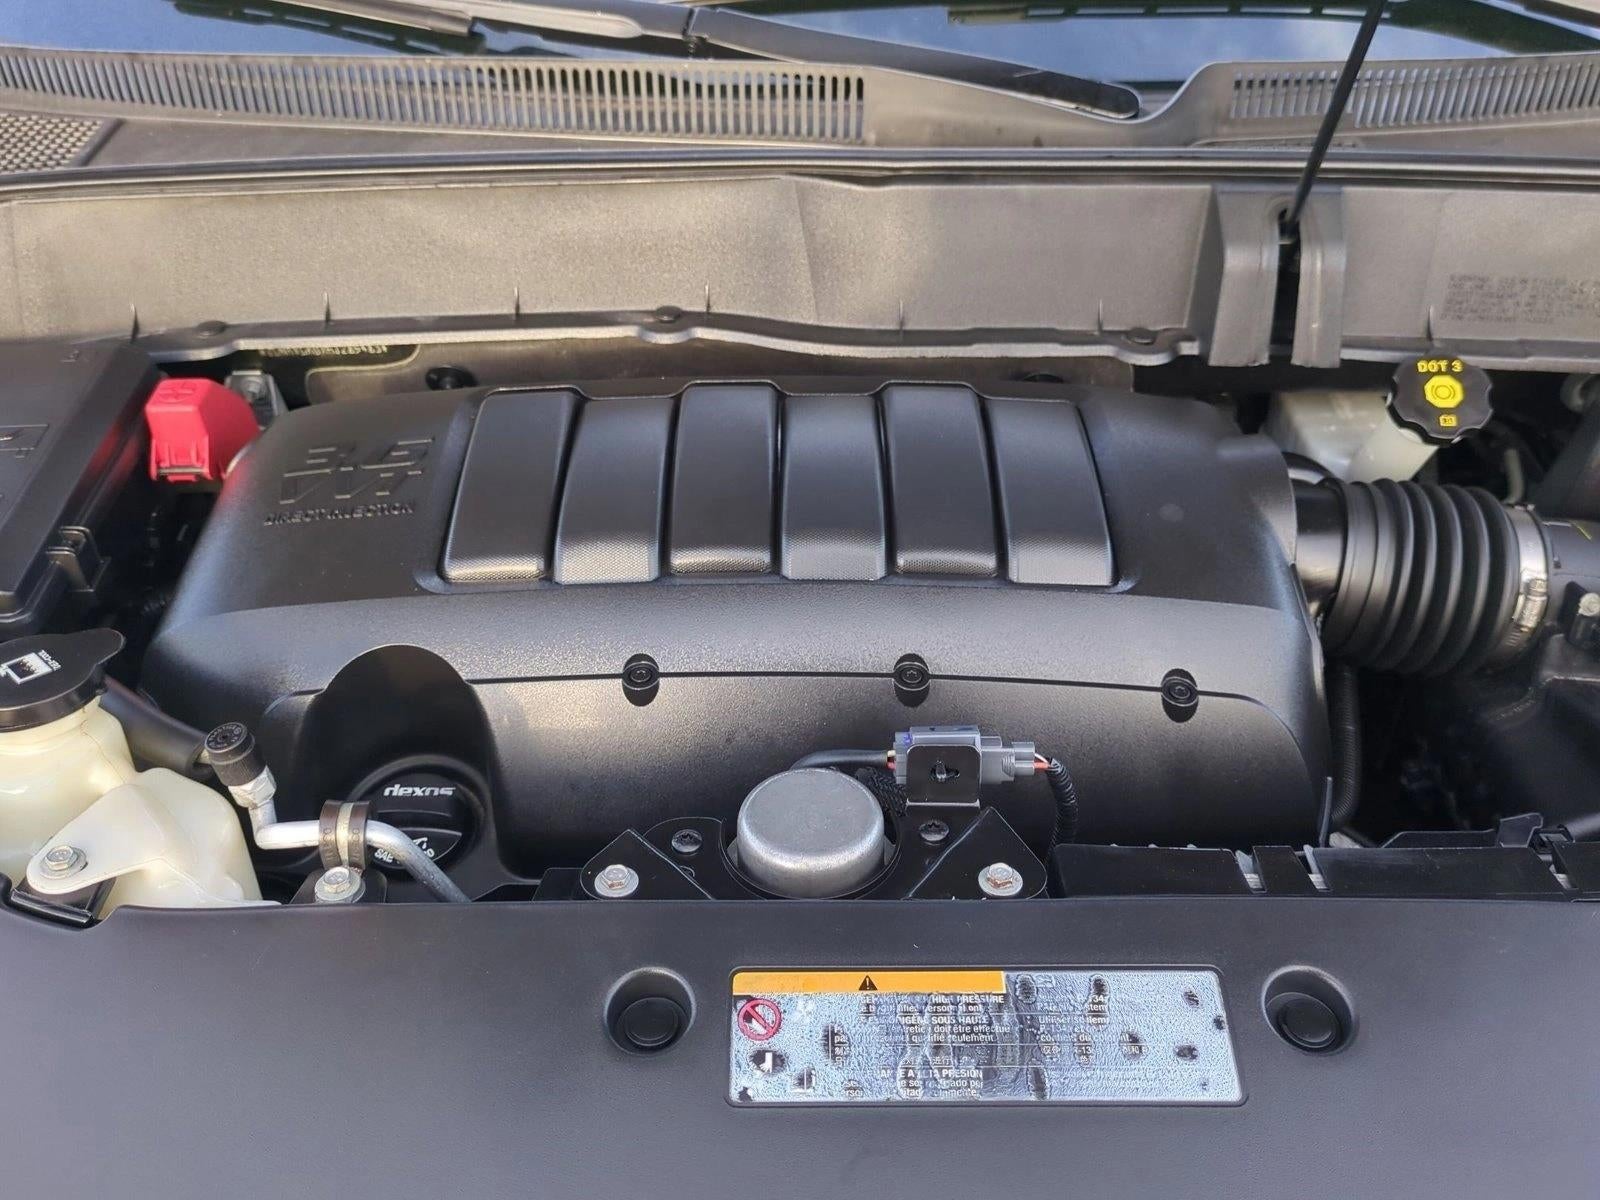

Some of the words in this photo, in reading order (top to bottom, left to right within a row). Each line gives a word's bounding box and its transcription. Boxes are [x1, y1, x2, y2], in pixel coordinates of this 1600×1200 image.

[1417, 360, 1448, 372] DOT
[1451, 360, 1463, 372] 3
[374, 848, 394, 863] SAE
[931, 1015, 956, 1024] SOUS
[934, 1024, 951, 1033] doit
